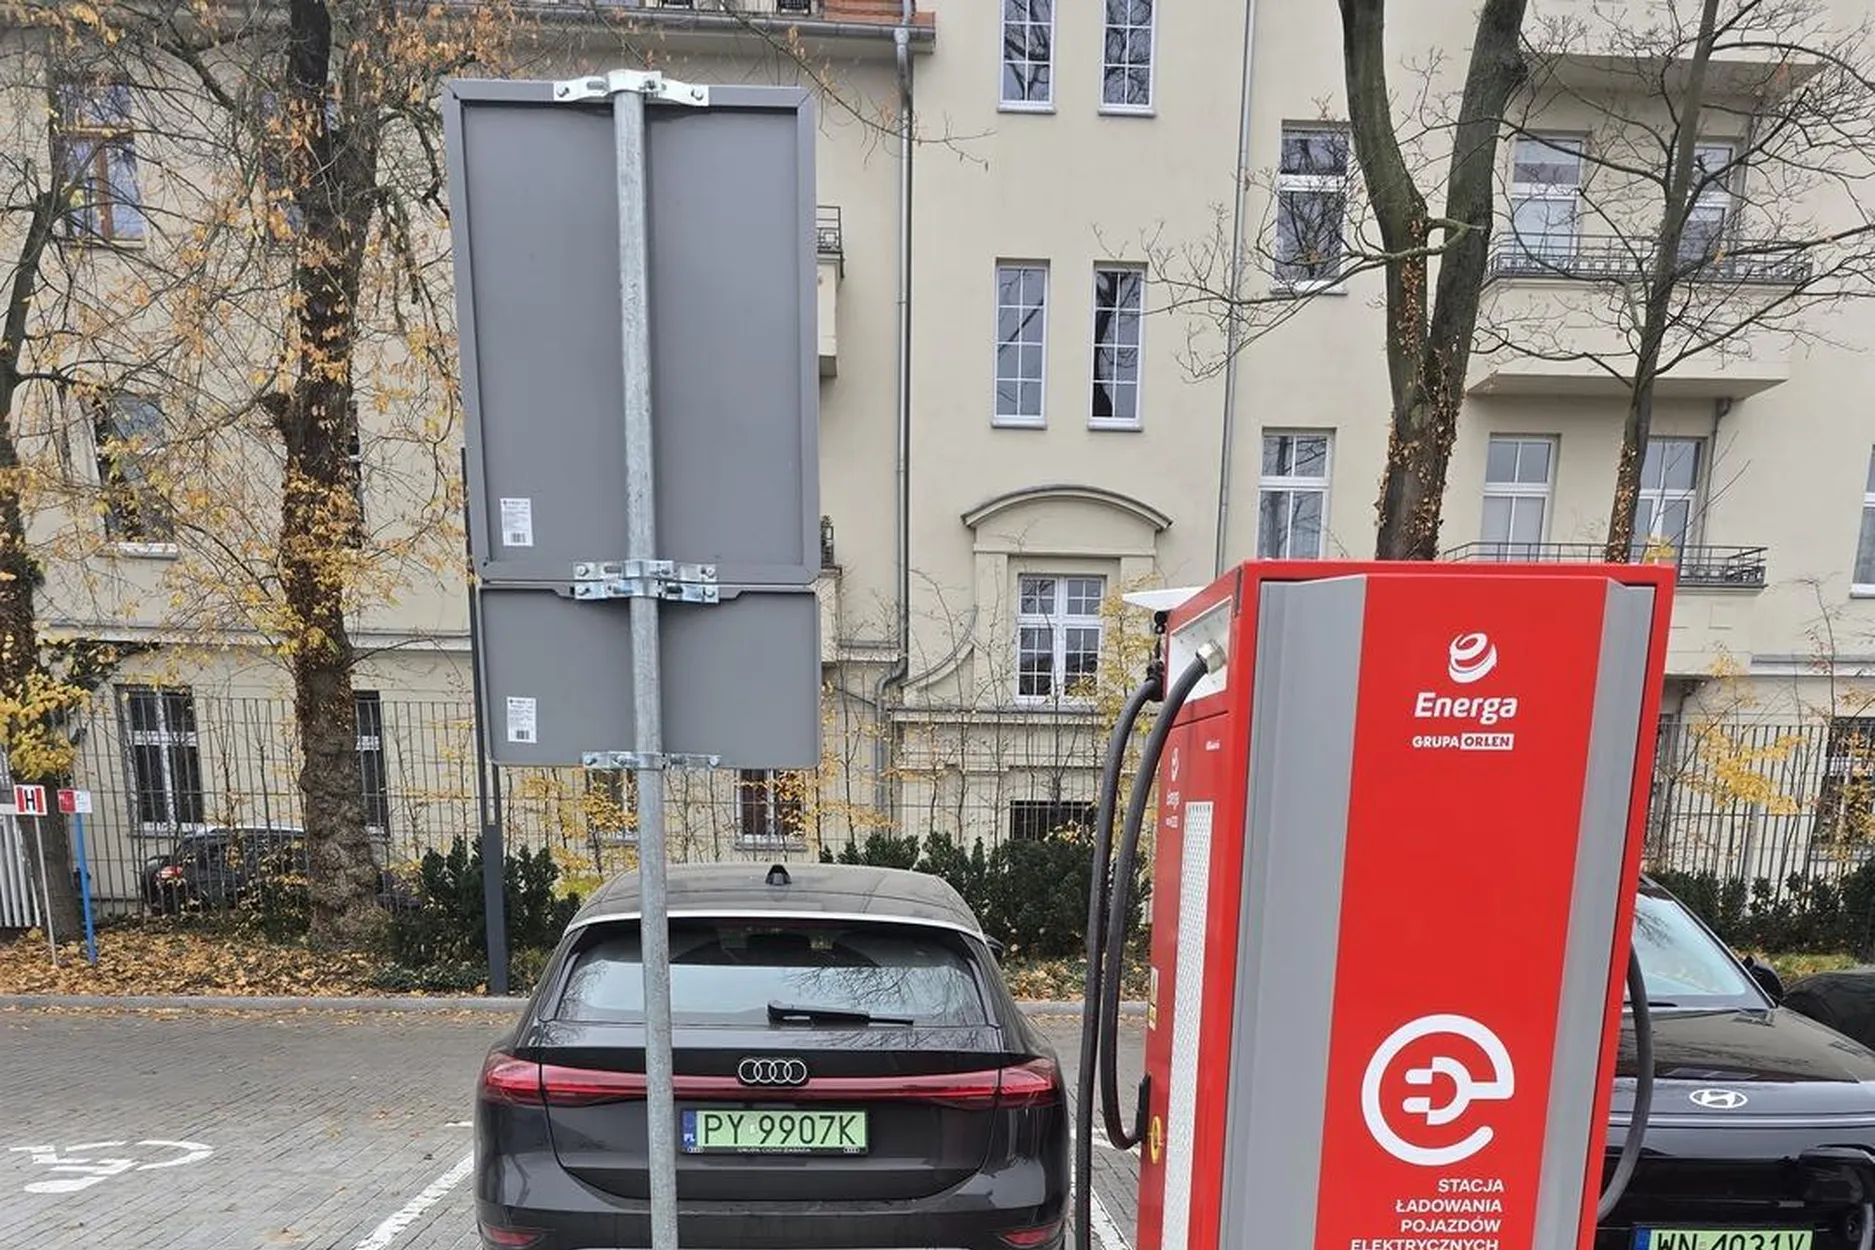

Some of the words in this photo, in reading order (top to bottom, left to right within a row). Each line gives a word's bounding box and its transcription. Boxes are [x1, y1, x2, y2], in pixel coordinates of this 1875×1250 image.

[1414, 691, 1518, 725] Energa
[1412, 735, 1459, 748] GRUPA
[1463, 735, 1512, 748] ORLEN
[24, 789, 36, 811] H
[704, 1114, 745, 1145] PY
[758, 1114, 857, 1145] 9907K
[1438, 1178, 1504, 1193] STACJA
[1395, 1199, 1503, 1213] ŁADOWANIA
[1401, 1216, 1501, 1233] POJAZDÓW
